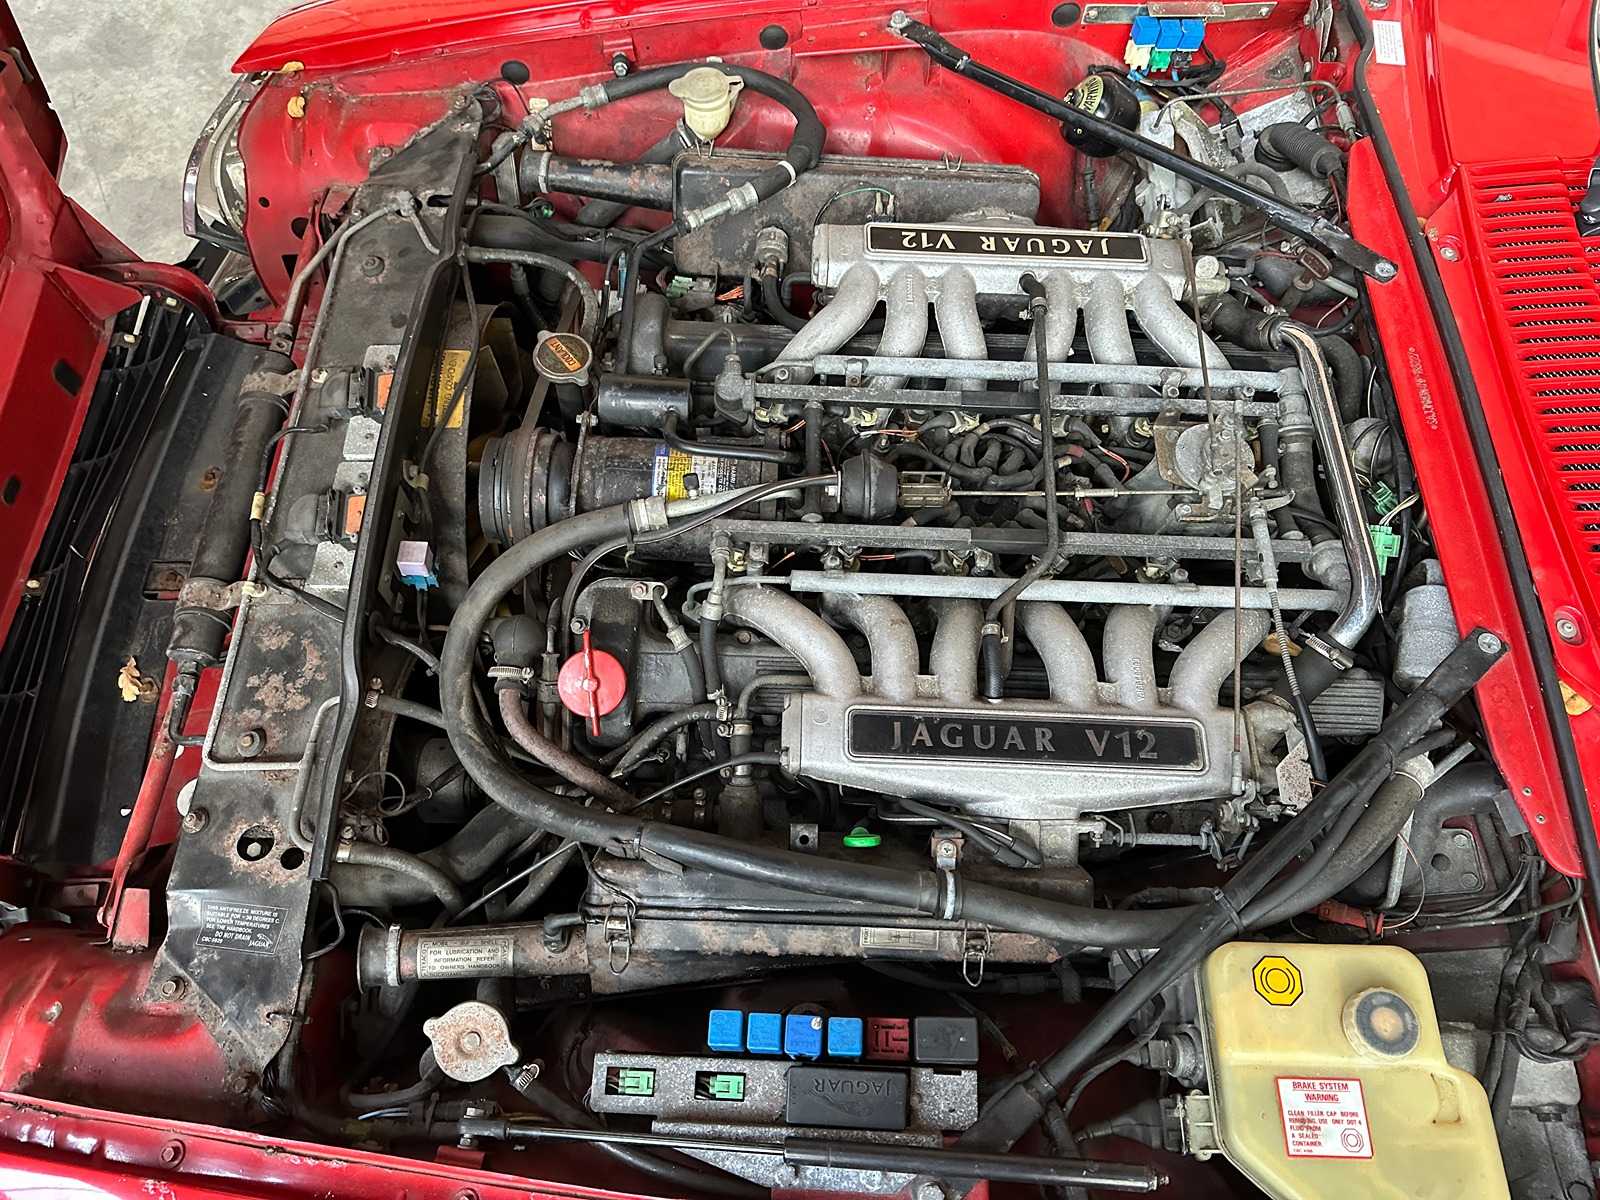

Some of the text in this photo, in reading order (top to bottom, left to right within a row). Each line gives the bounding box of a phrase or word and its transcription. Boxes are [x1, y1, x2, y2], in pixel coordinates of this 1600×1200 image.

[900, 231, 1110, 255] JAGUAR V12
[550, 341, 577, 366] COOLANT
[890, 720, 1159, 759] JAGUAR V12
[250, 909, 271, 917] MIXTURE
[234, 920, 270, 930] TEMPERATURES
[253, 916, 274, 924] DEGREES
[234, 933, 251, 941] DRAIN
[248, 939, 270, 948] JAGUAR
[813, 1078, 892, 1097] JAGUAR
[1292, 1081, 1349, 1091] BRAKE SYSTEM
[1304, 1093, 1340, 1102] WARNING
